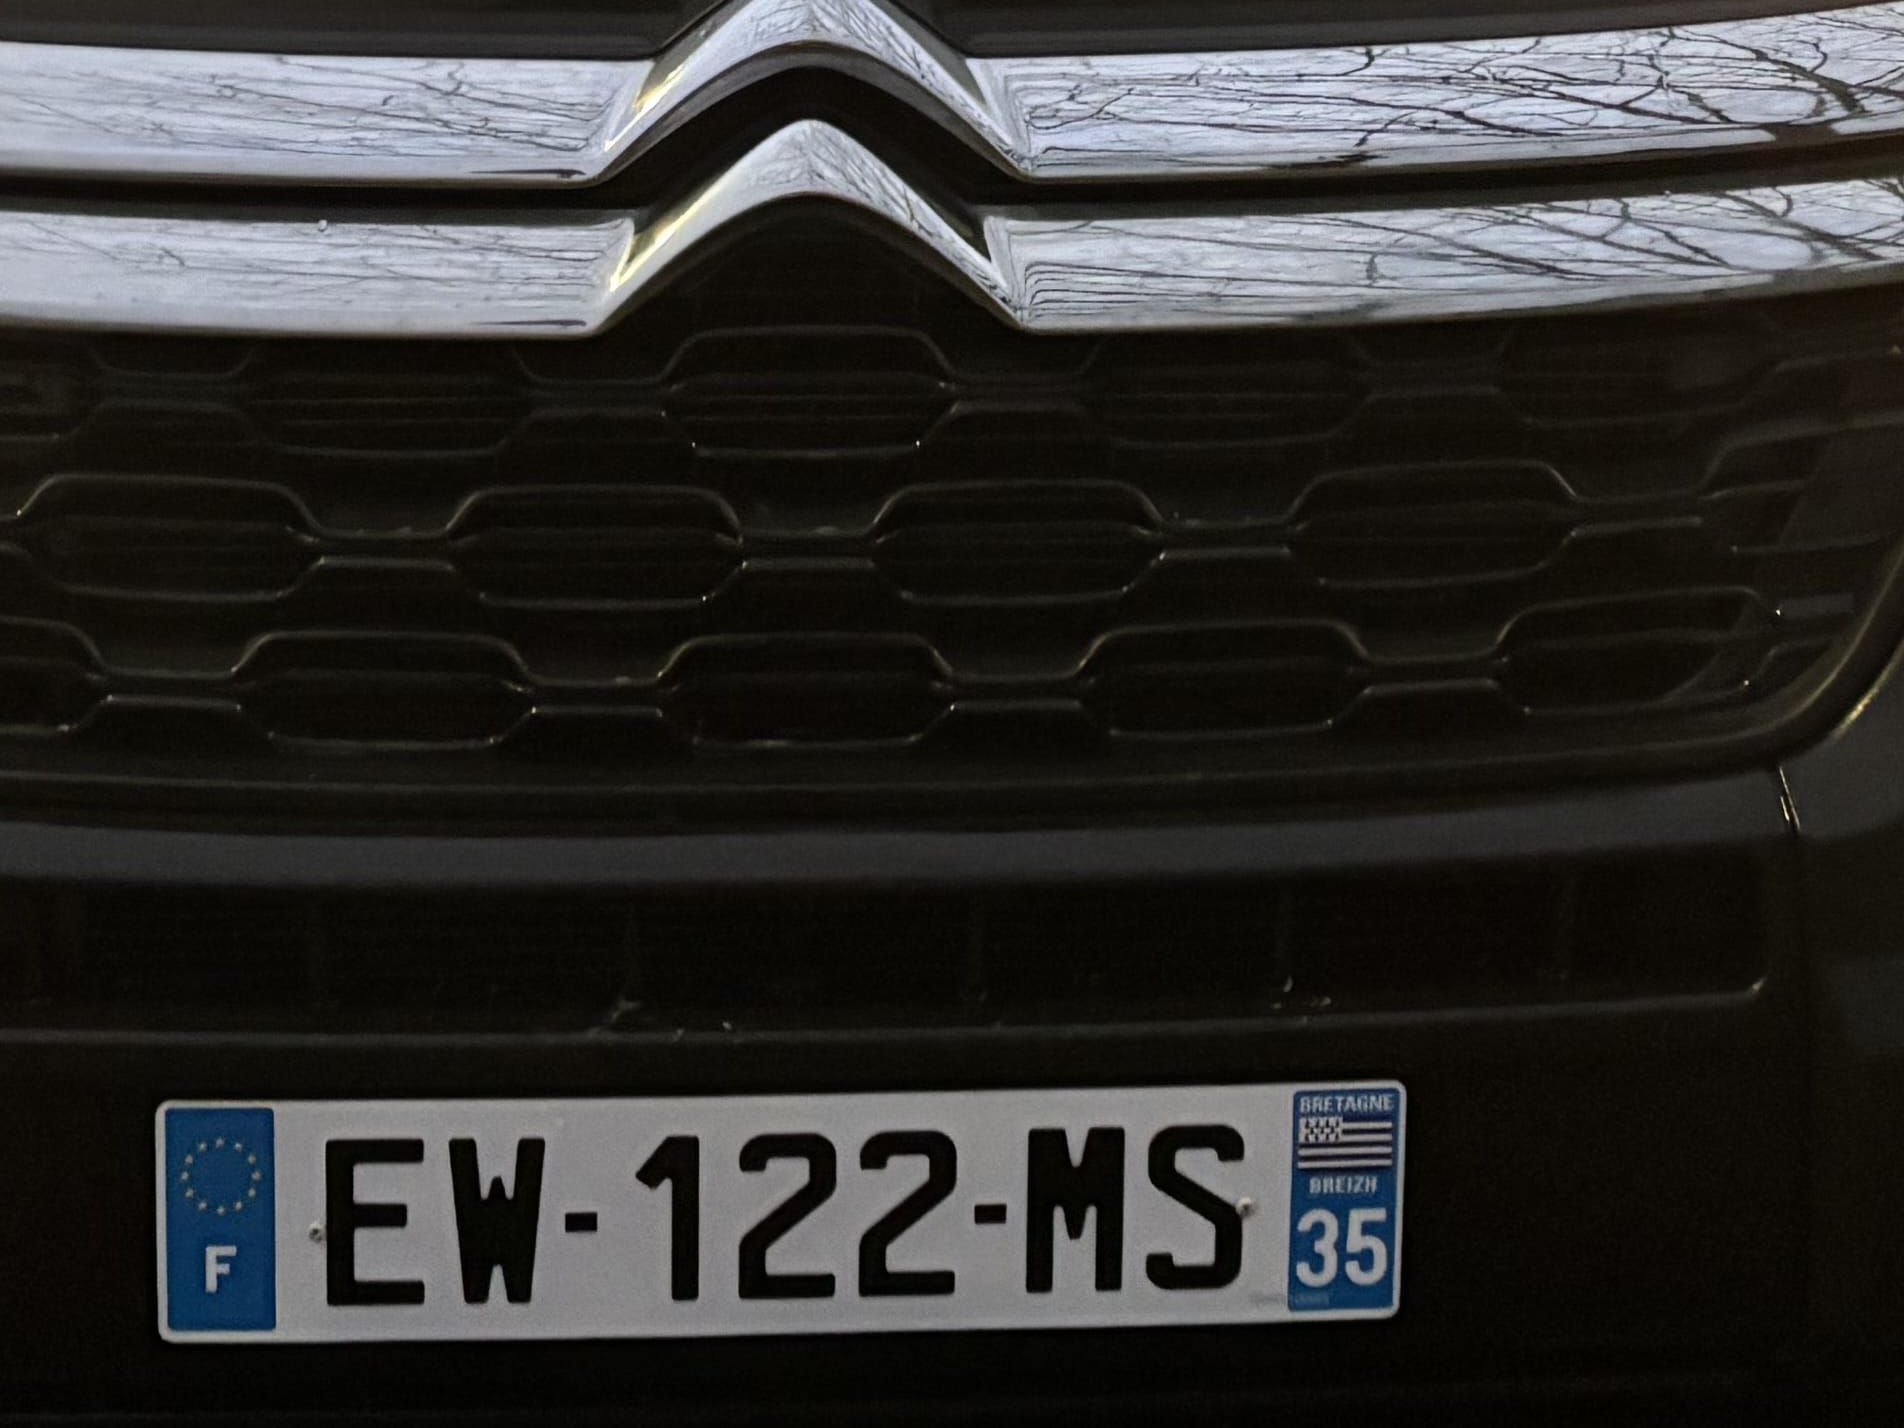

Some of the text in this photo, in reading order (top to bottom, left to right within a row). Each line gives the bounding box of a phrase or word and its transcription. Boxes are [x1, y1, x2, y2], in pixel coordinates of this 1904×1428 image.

[1299, 1095, 1394, 1115] BRETAGNE
[1309, 1176, 1378, 1195] BREIZH
[325, 1124, 1247, 1307] EW-122-MS
[203, 1244, 238, 1293] F
[1296, 1208, 1388, 1288] 35
